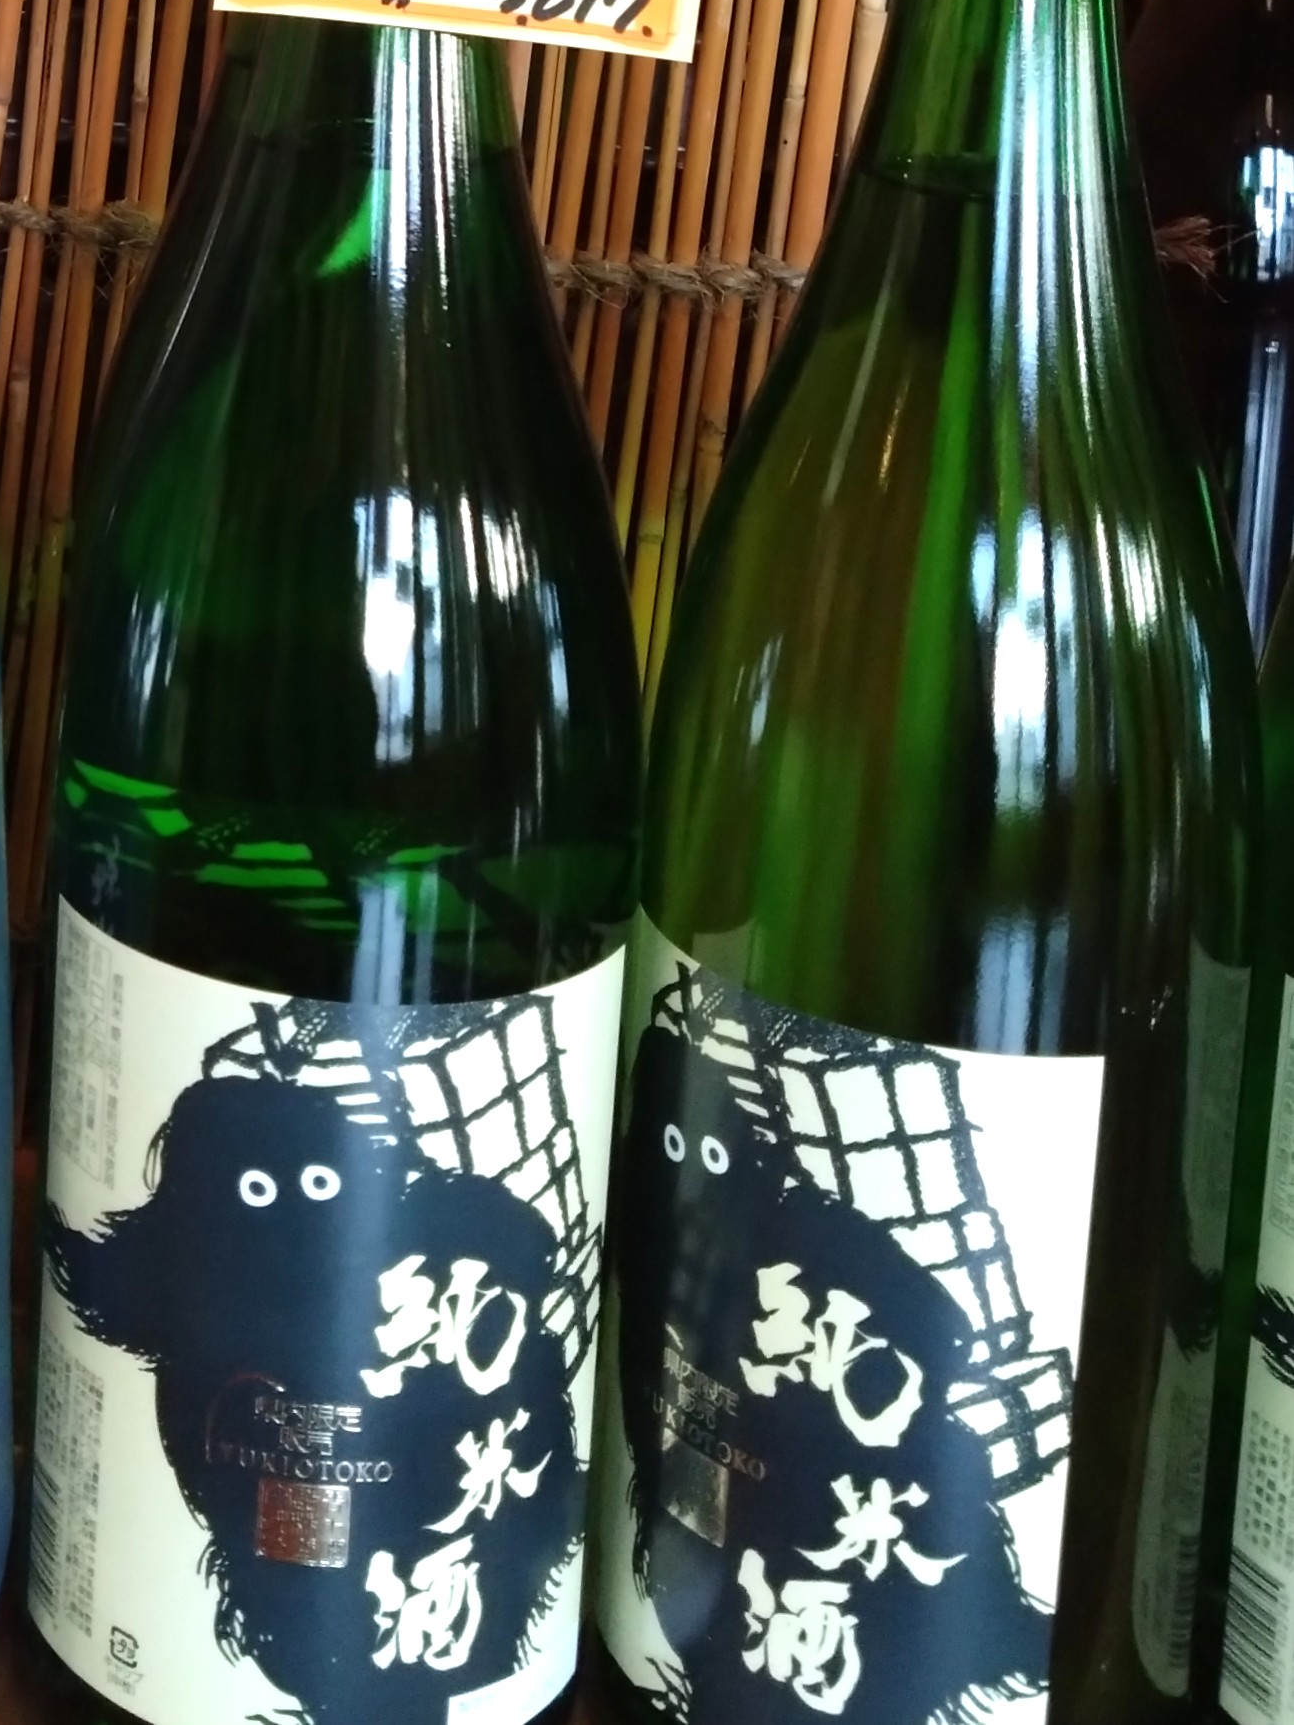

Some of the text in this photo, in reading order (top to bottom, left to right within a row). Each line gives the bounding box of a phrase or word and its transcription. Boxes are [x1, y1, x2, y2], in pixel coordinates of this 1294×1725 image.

[360, 1254, 553, 1672] 純米酒
[736, 1261, 968, 1715] 純米酒
